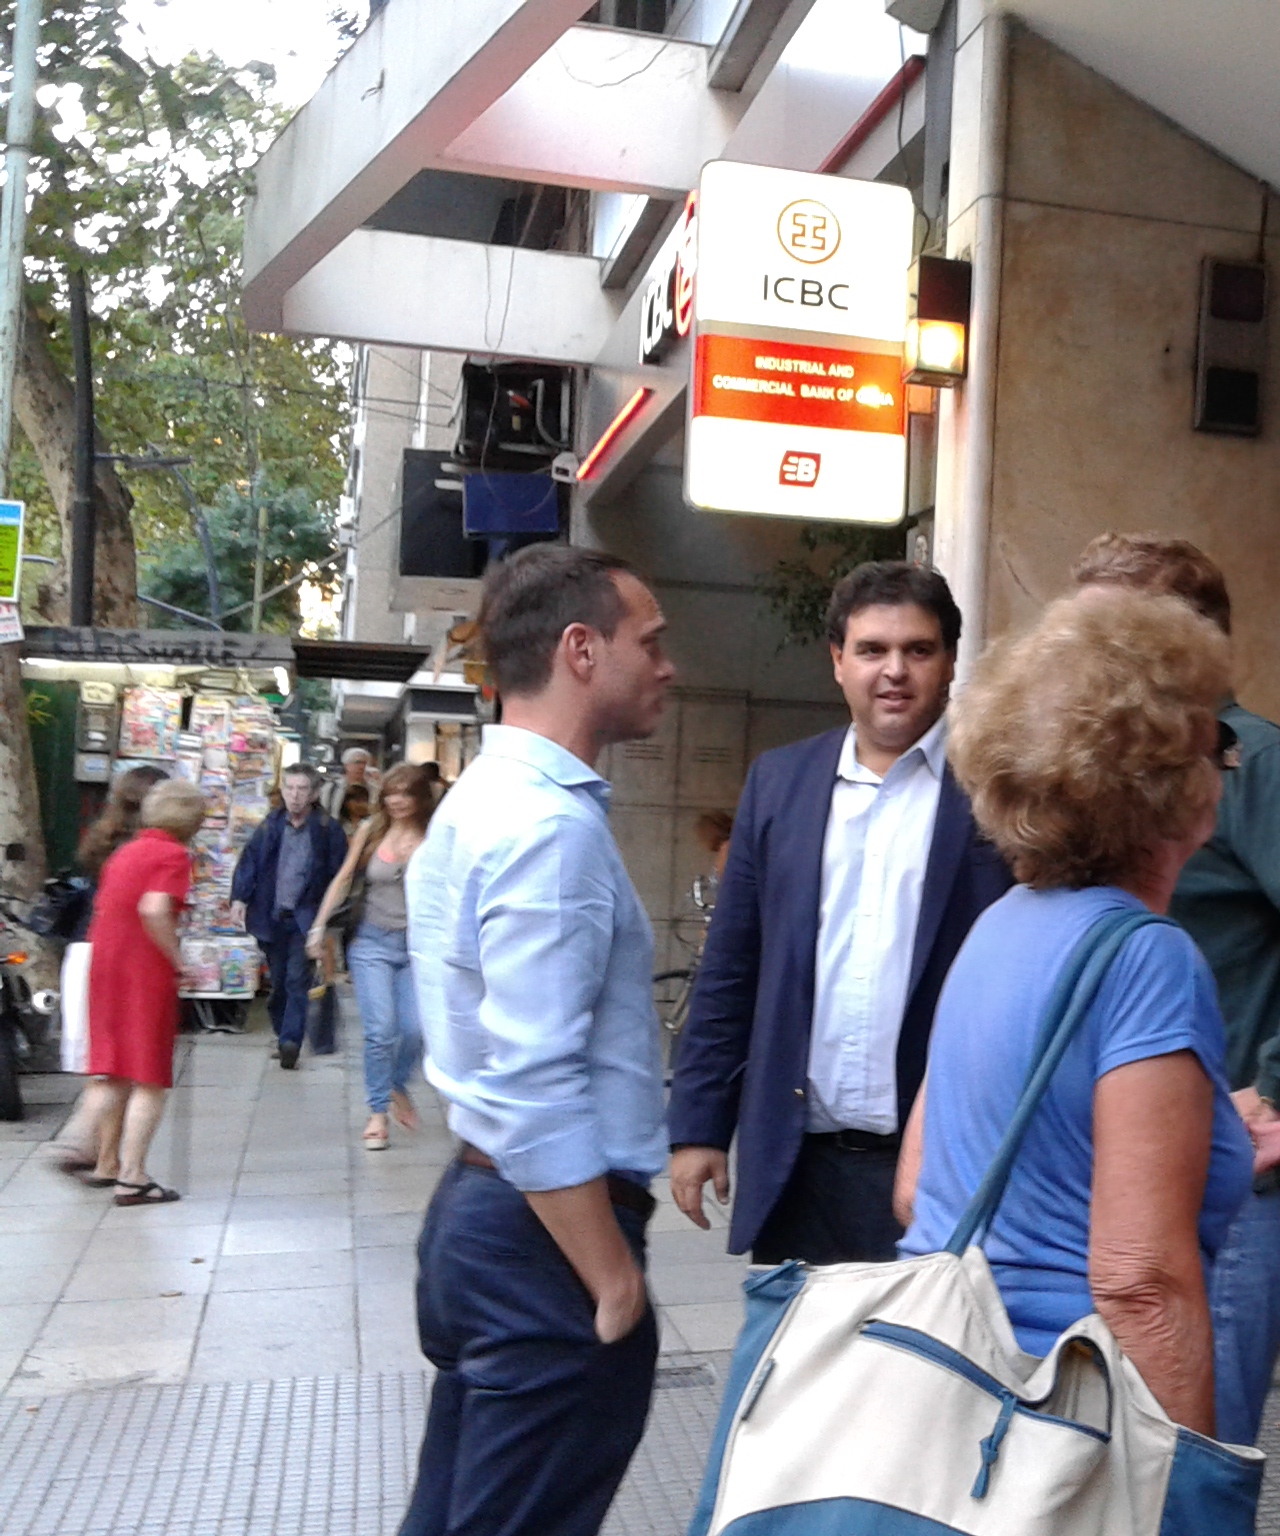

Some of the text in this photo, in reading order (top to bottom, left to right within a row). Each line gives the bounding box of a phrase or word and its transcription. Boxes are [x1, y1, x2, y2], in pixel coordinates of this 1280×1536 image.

[764, 274, 849, 310] ICBC
[755, 356, 854, 379] INDUSTRIAL AND
[712, 374, 894, 406] COMMERCIAL BANK OF CNA
